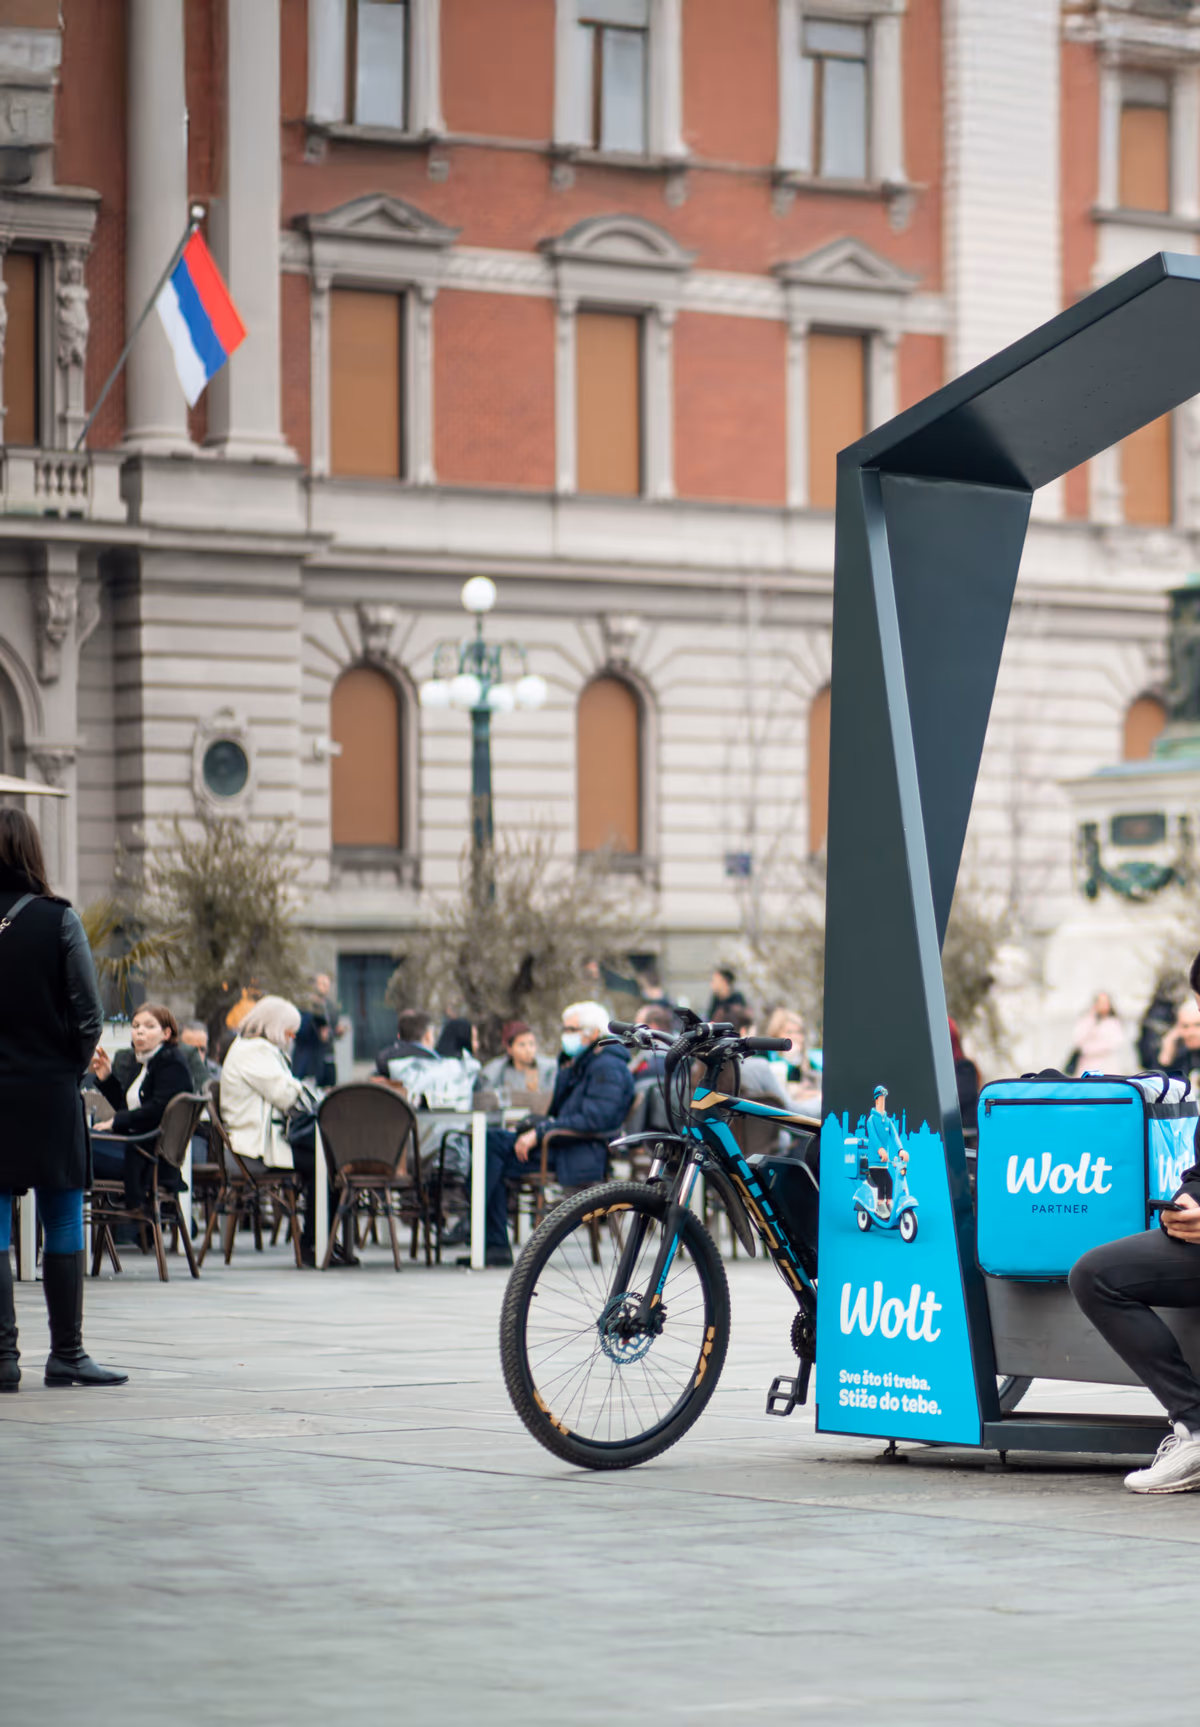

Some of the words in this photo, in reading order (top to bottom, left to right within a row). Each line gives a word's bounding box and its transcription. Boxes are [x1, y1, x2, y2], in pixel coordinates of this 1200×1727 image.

[1007, 1152, 1113, 1194] Wolt
[1031, 1204, 1088, 1214] PARTNER
[839, 1281, 942, 1342] Wolt
[839, 1369, 861, 1384] Sve
[862, 1369, 882, 1386] što
[883, 1372, 893, 1387] ti
[893, 1374, 931, 1391] treba.
[839, 1388, 877, 1409] Stiže
[879, 1391, 900, 1411] do
[901, 1394, 942, 1415] tebe.
